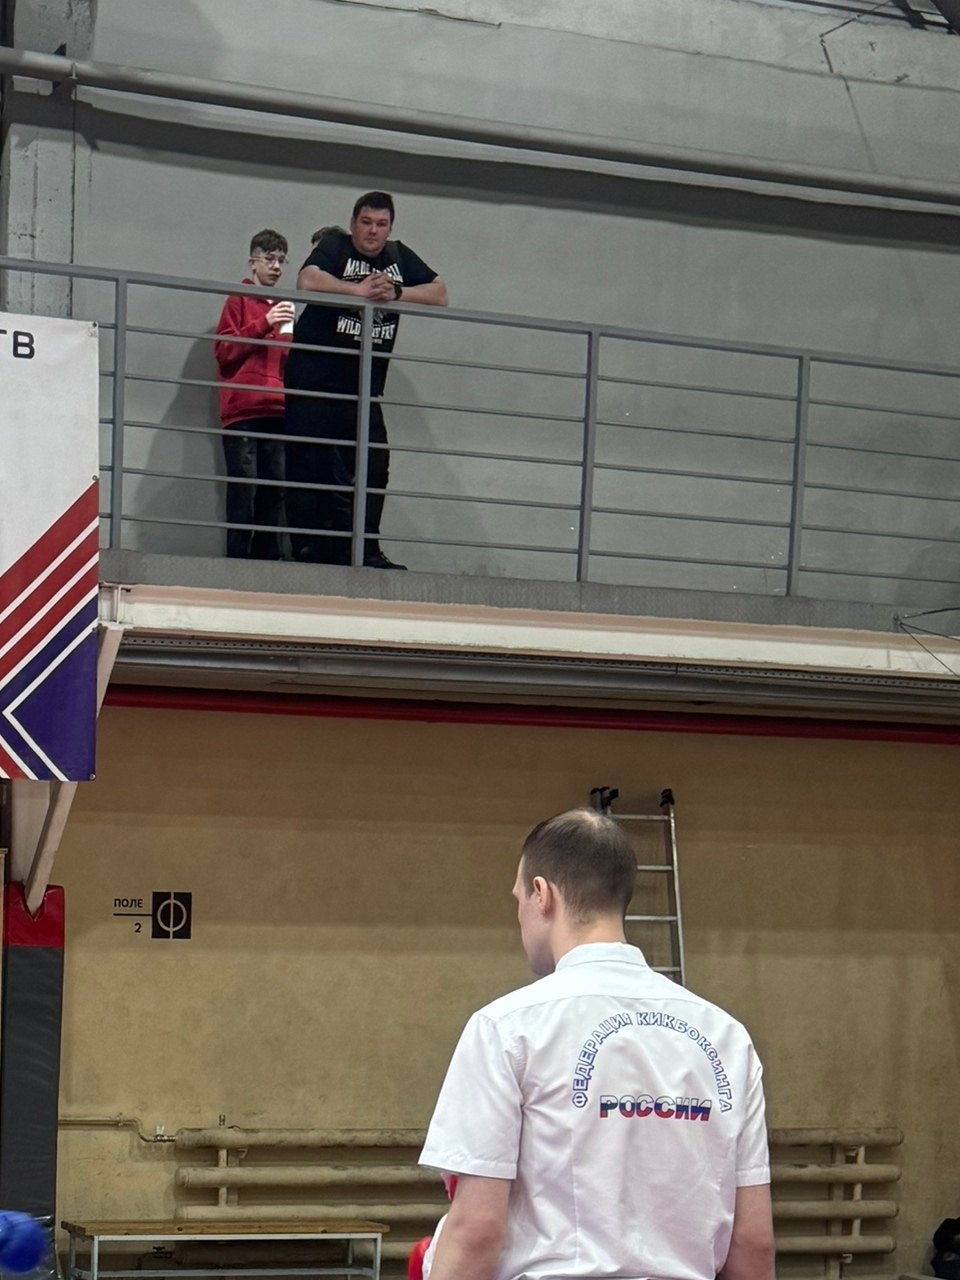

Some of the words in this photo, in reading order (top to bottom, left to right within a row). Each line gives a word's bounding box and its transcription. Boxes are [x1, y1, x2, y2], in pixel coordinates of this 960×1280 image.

[113, 898, 143, 908] ПОЛЕ
[134, 922, 142, 933] 2
[636, 1011, 732, 1113] КИКБОКСИНГА
[599, 1094, 713, 1122] РОССИИ
